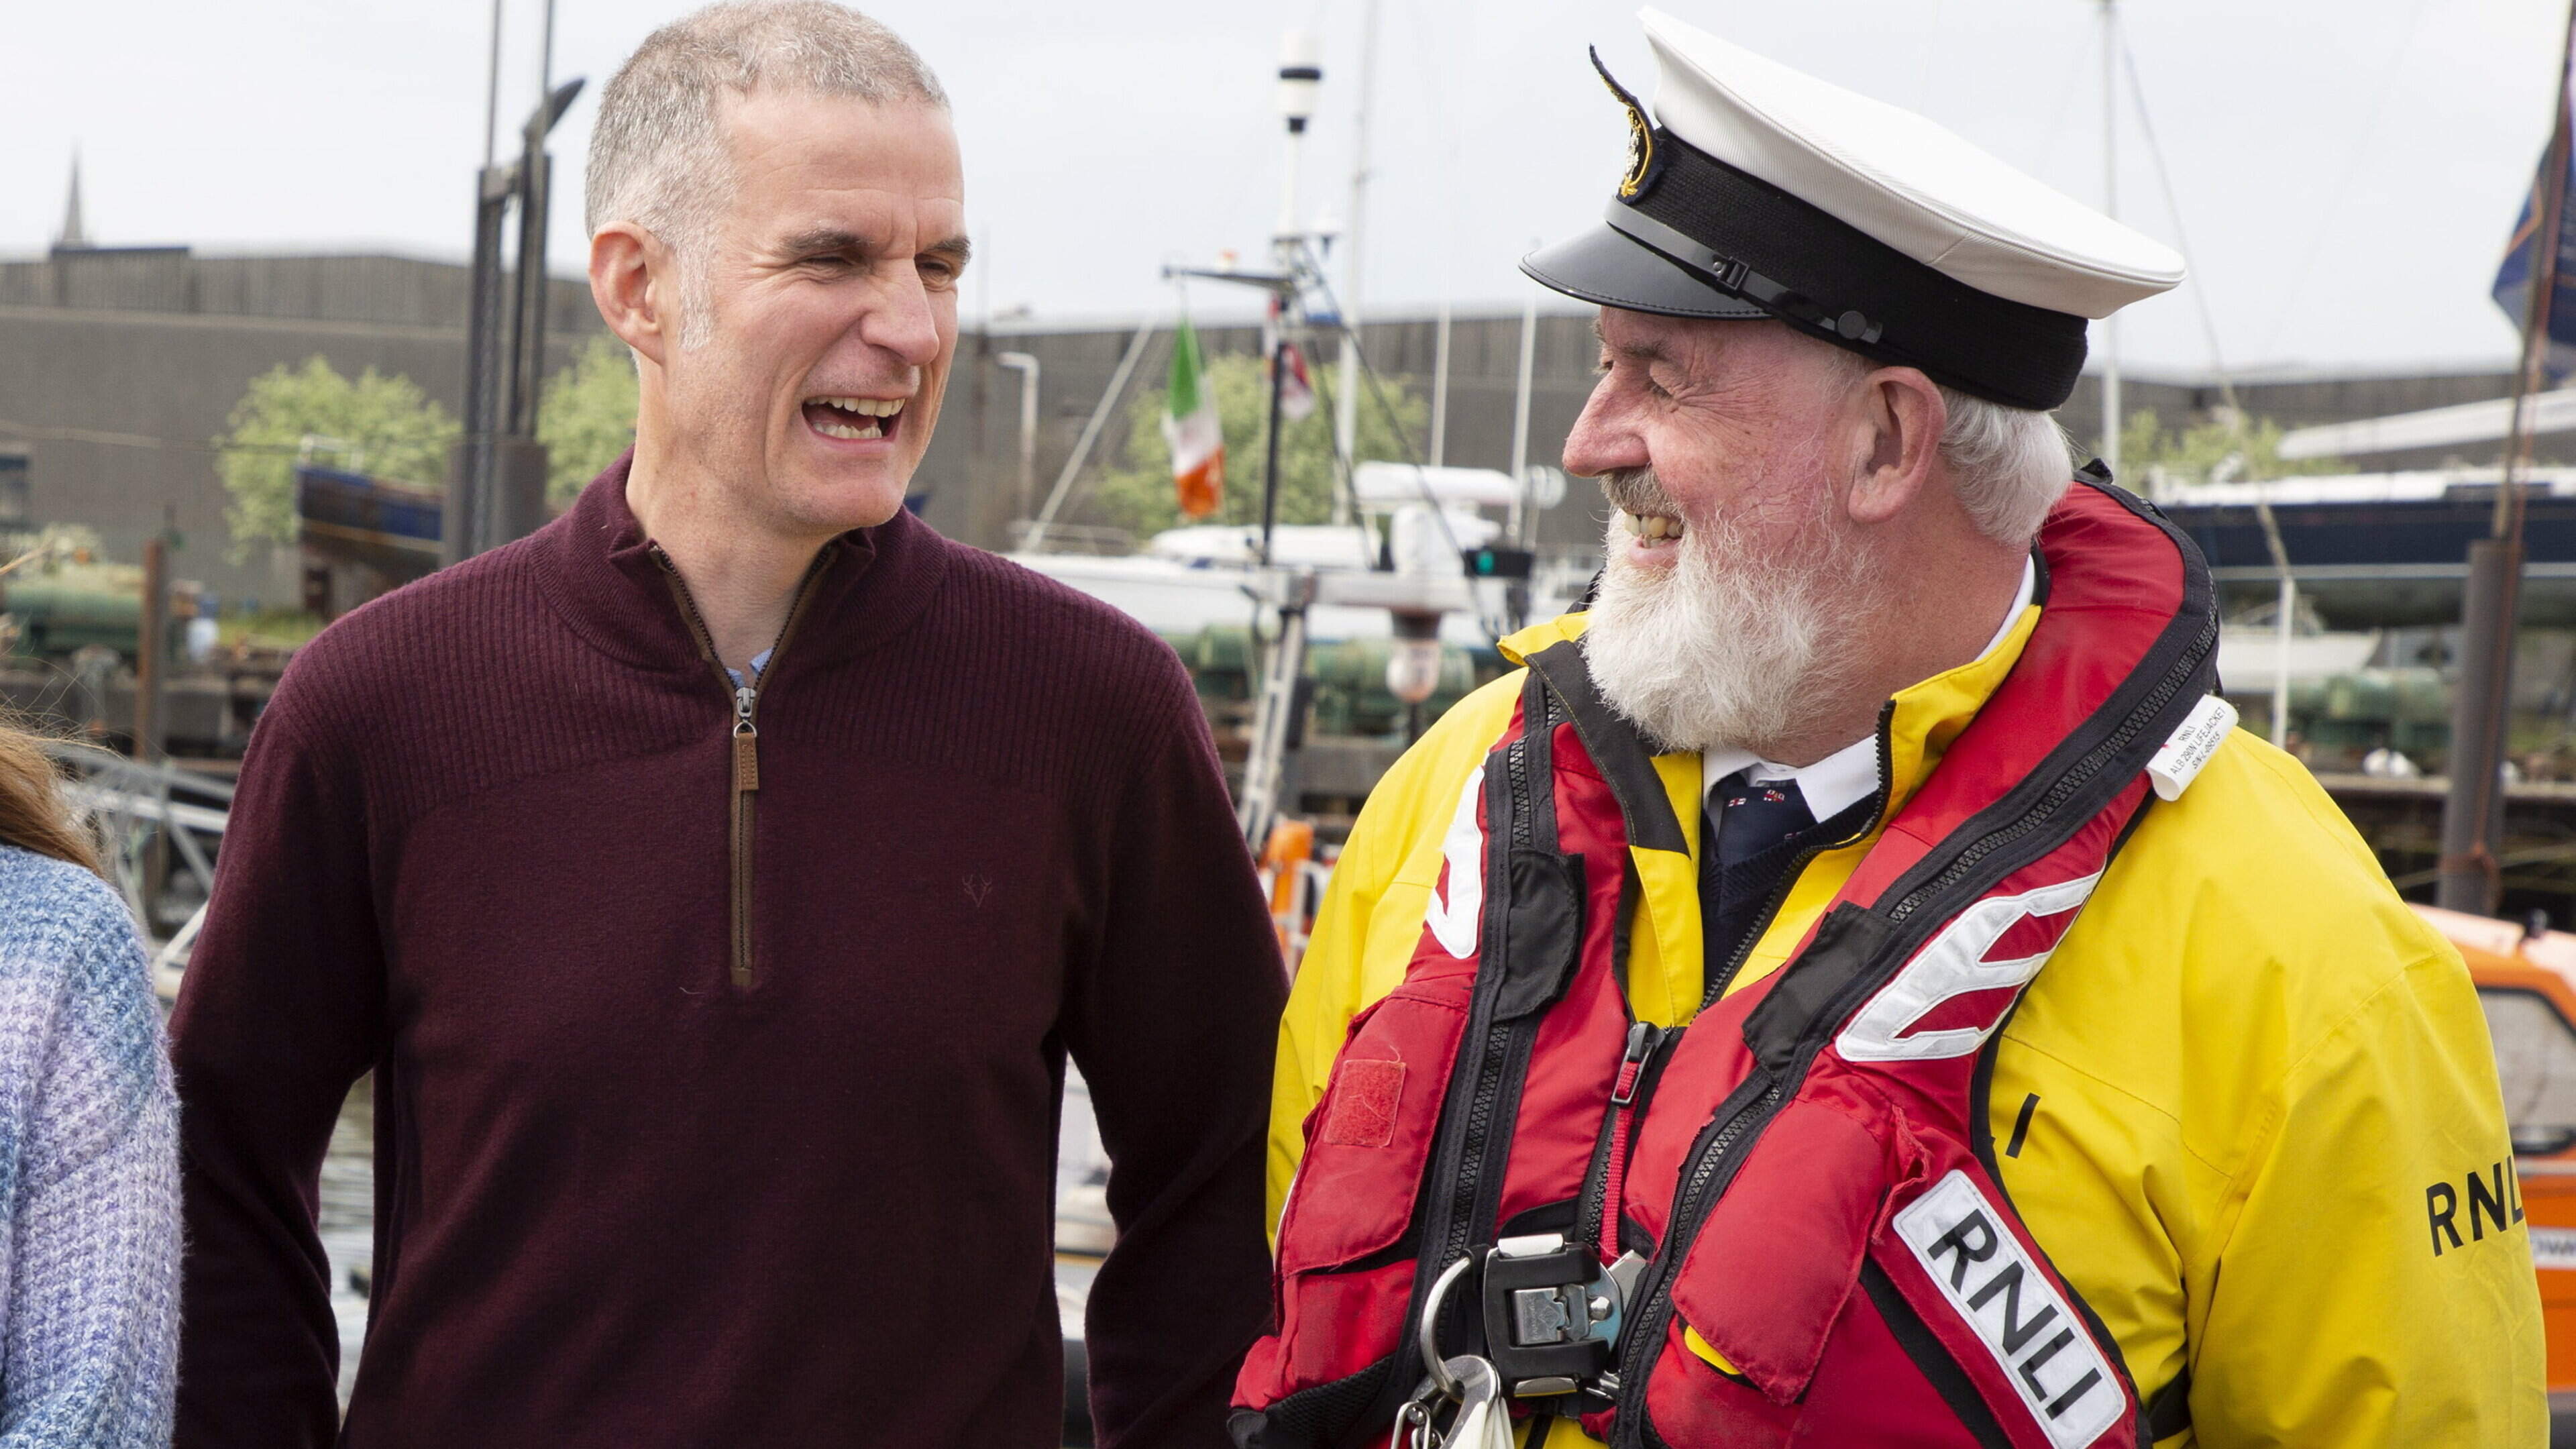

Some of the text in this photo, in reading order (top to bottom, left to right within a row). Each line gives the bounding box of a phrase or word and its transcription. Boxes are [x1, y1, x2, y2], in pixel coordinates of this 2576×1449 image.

[2169, 706, 2226, 774] ALB 290N LIFEJACKET
[2178, 725, 2196, 742] RNLI
[1927, 1208, 2102, 1421] RNLI
